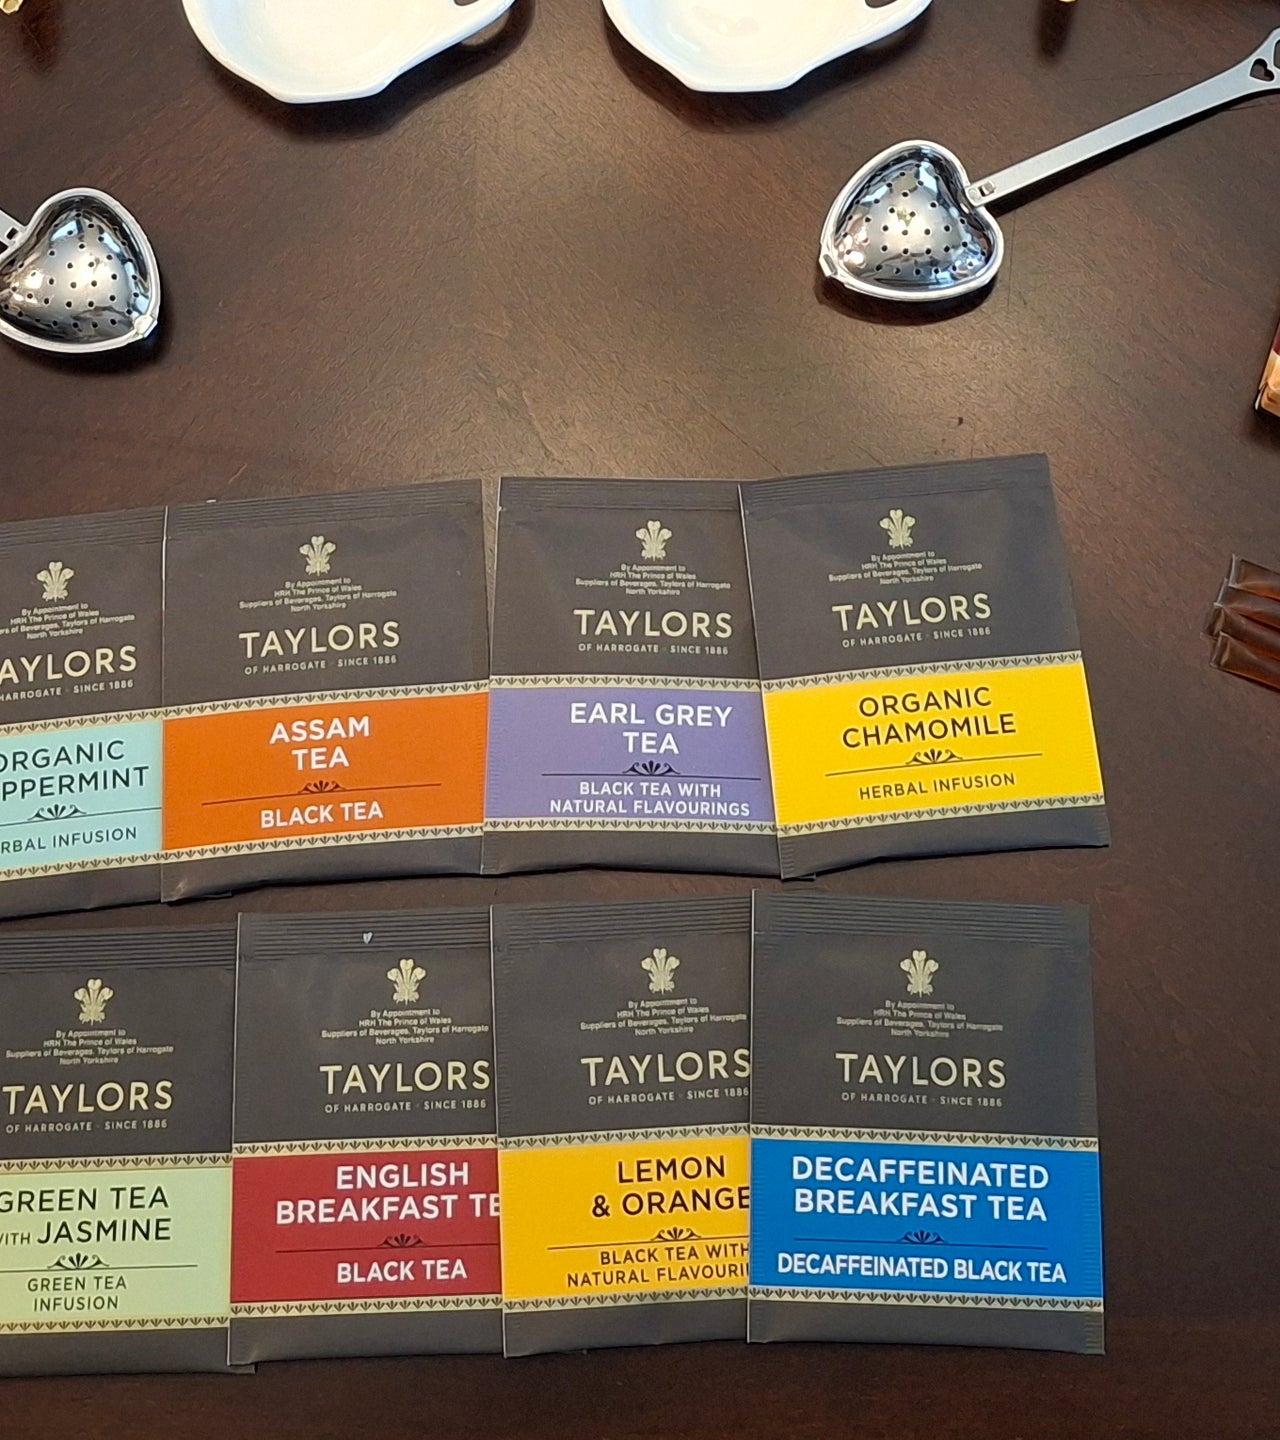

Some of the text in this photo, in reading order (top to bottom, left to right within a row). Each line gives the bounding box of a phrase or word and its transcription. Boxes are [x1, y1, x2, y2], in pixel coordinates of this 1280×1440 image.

[573, 609, 732, 638] TAYLORS
[832, 593, 991, 631] TAYLORS
[238, 621, 399, 658] TAYLORS
[578, 643, 728, 655] OF HARROGATE SINCE 1886
[842, 627, 991, 648] OF HARROGATE SINCE 1886
[244, 655, 396, 675] OF HARROGATE SINCE 1886
[73, 682, 105, 693] SINCE
[109, 679, 133, 689] 1886
[571, 703, 732, 727] EARL GREY
[859, 687, 991, 717] ORGANIC
[269, 716, 369, 744] ASSAM
[623, 732, 679, 754] TEA
[843, 713, 1016, 748] CHAMOMILE
[292, 746, 349, 770] TEA
[580, 781, 721, 797] BLACK TEA WITH
[859, 773, 1015, 800] HERBAL INFUSION
[261, 801, 383, 828] BLACK TEA
[550, 799, 750, 816] NATURAL FLAVOURINGS
[53, 827, 136, 848] INFUSION
[320, 1060, 490, 1095] TAYLORS
[581, 1048, 750, 1086] TAYLORS
[835, 1053, 1005, 1088] TAYLORS
[2, 1081, 172, 1115] TAYLORS
[325, 1099, 486, 1113] OF HARROGATE SINCE 1886
[588, 1087, 749, 1105] OF HARROGATE SINCE 1886
[841, 1092, 1002, 1107] OF HARROGATE SINCE 1886
[6, 1119, 167, 1134] OF HARROGATE SINCE 1886
[337, 1162, 468, 1189] ENGLISH
[618, 1155, 725, 1183] LEMON
[793, 1156, 1049, 1188] DECAFFEINATED
[110, 1186, 168, 1210] TEA
[277, 1193, 500, 1224] BREAKFAST TE
[592, 1186, 749, 1218] & ORANGE
[795, 1188, 1047, 1221] BREAKFAST TEA
[37, 1218, 171, 1244] JASMINE
[600, 1243, 749, 1265] BLACK TEA WITH
[337, 1259, 467, 1283] BLACK TEA
[567, 1262, 749, 1288] NATURAL FLAVOURI
[778, 1253, 1067, 1283] DECAFFEINATED BLACK TEA
[27, 1275, 127, 1292] GREEN TEA
[34, 1296, 118, 1312] INFUSION
